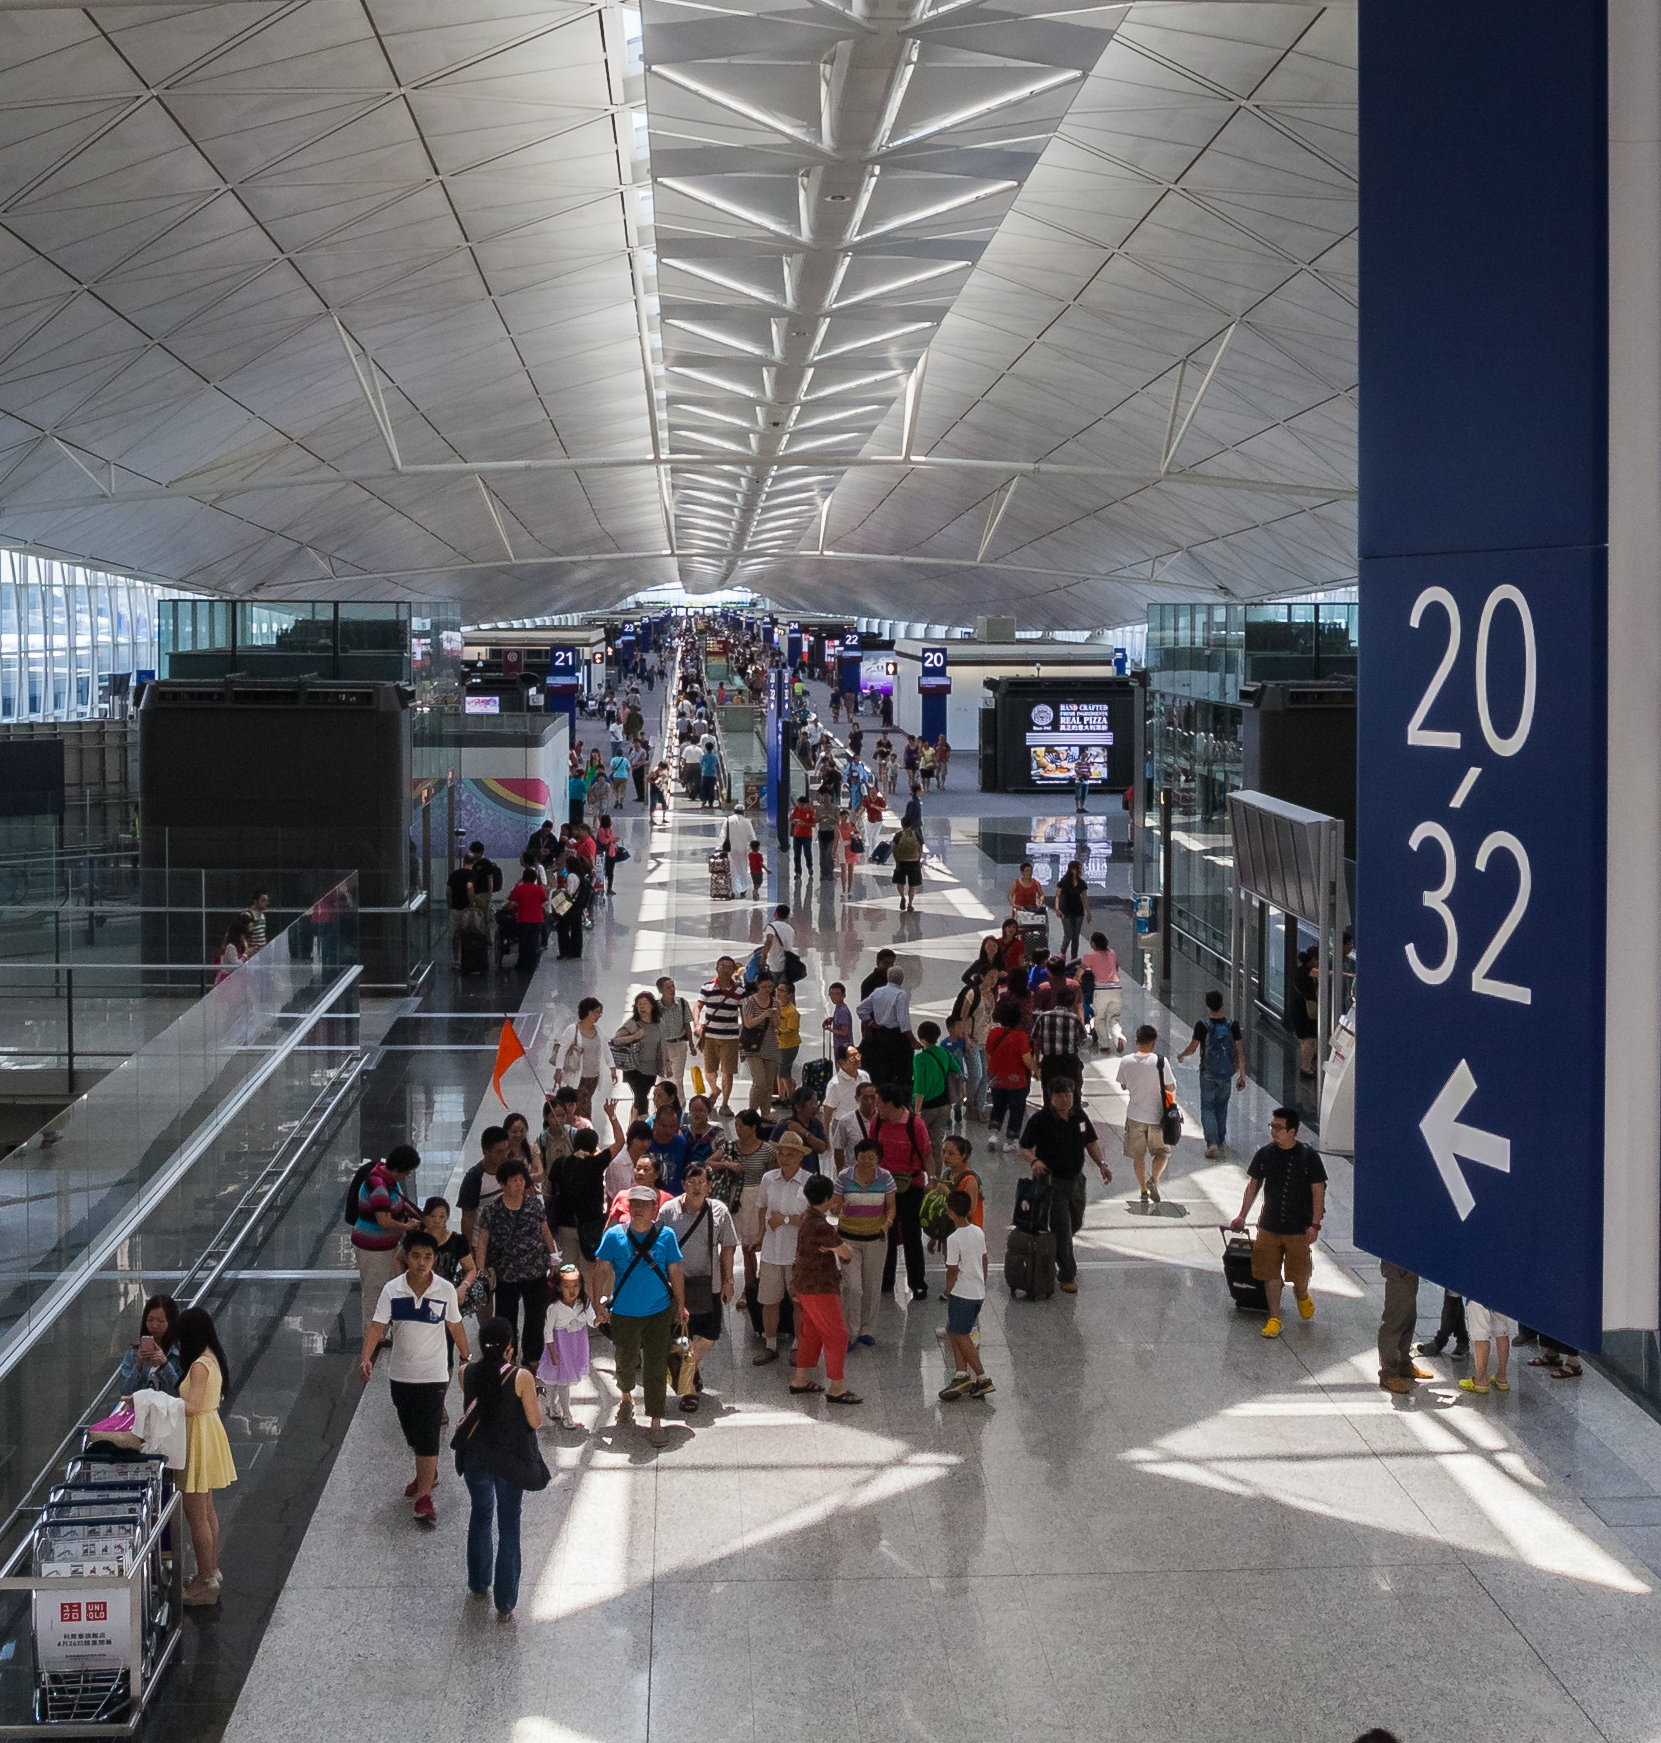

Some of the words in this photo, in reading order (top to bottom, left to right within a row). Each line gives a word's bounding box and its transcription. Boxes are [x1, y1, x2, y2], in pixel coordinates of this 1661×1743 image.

[624, 624, 634, 632] 23
[845, 634, 858, 645] 22
[554, 651, 572, 666] 21
[924, 652, 943, 667] 20
[1407, 584, 1536, 757] 20
[1405, 821, 1531, 1004] 32
